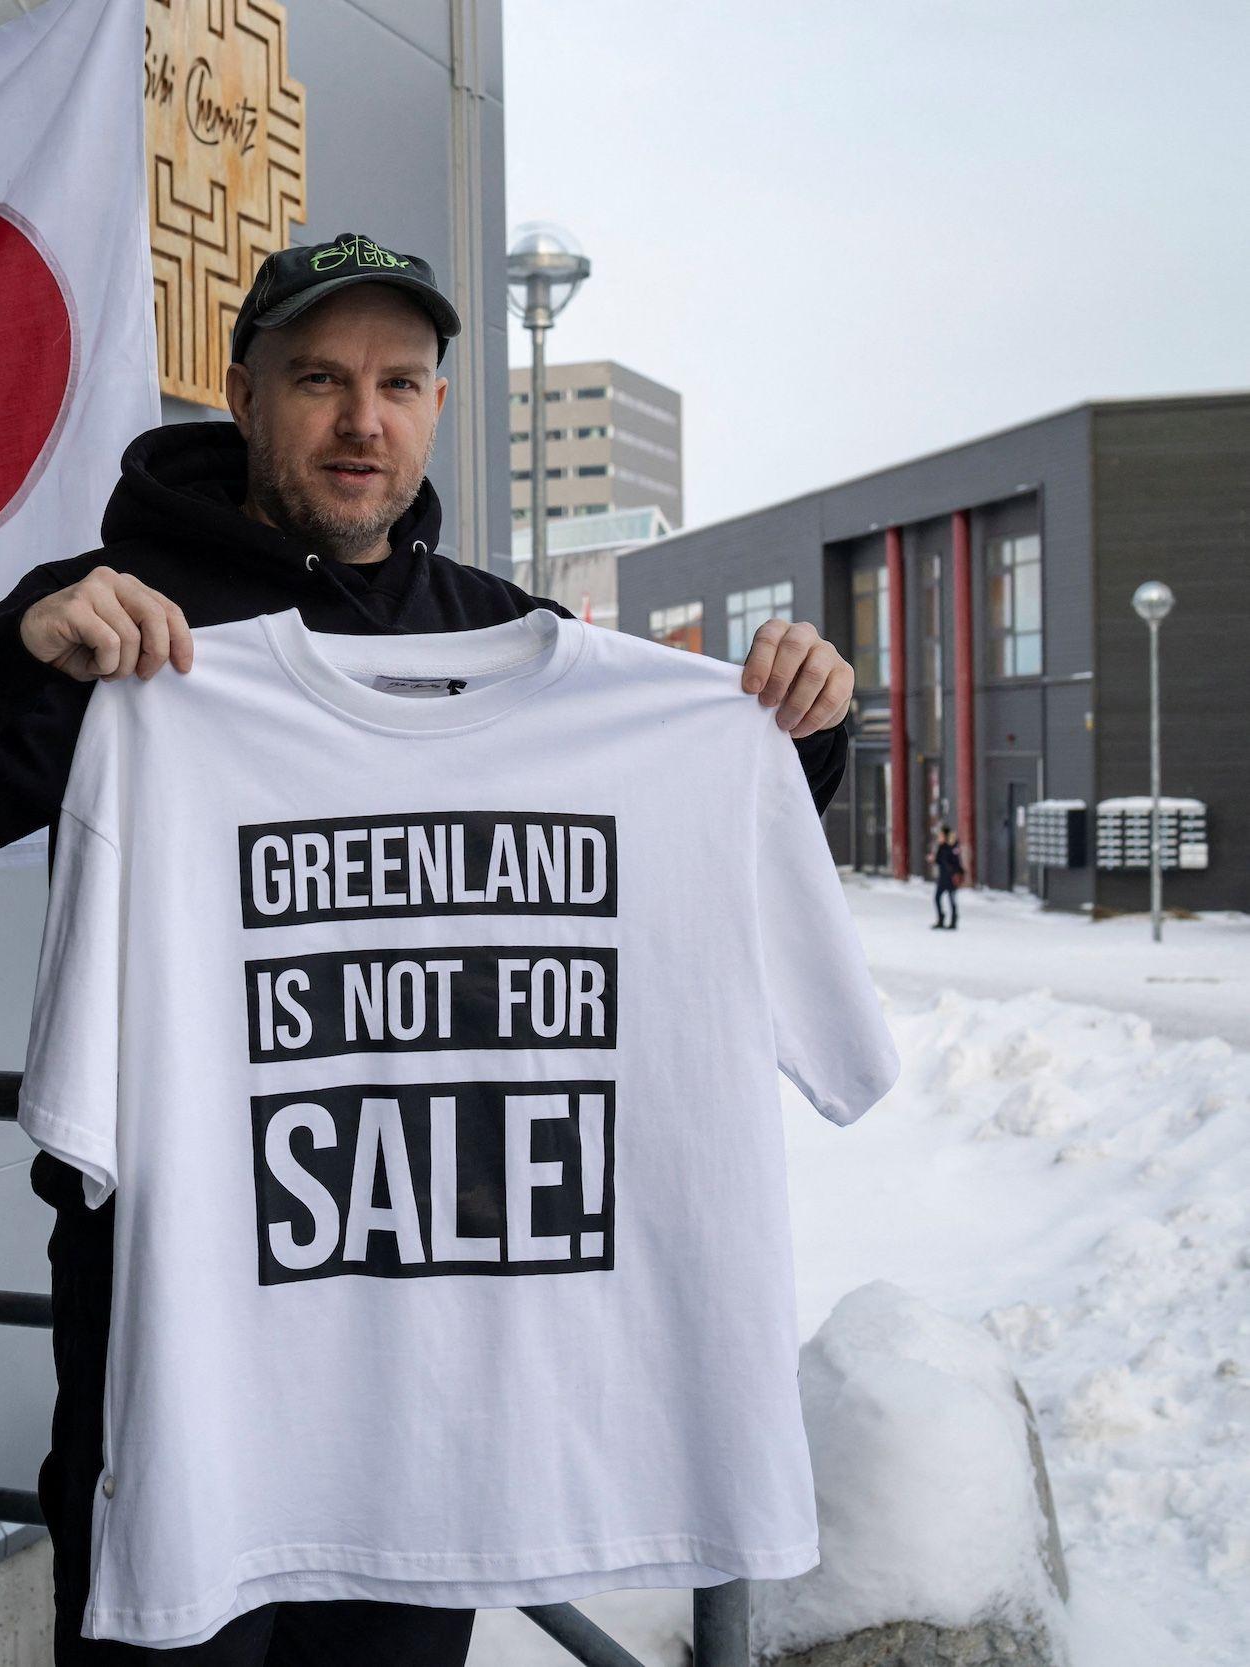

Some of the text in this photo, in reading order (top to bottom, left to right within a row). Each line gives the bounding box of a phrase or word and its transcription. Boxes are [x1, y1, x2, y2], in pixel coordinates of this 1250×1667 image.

[251, 823, 607, 915] GREENLAND
[257, 957, 606, 1051] IS NOT FOR
[264, 1093, 605, 1270] SALE!
